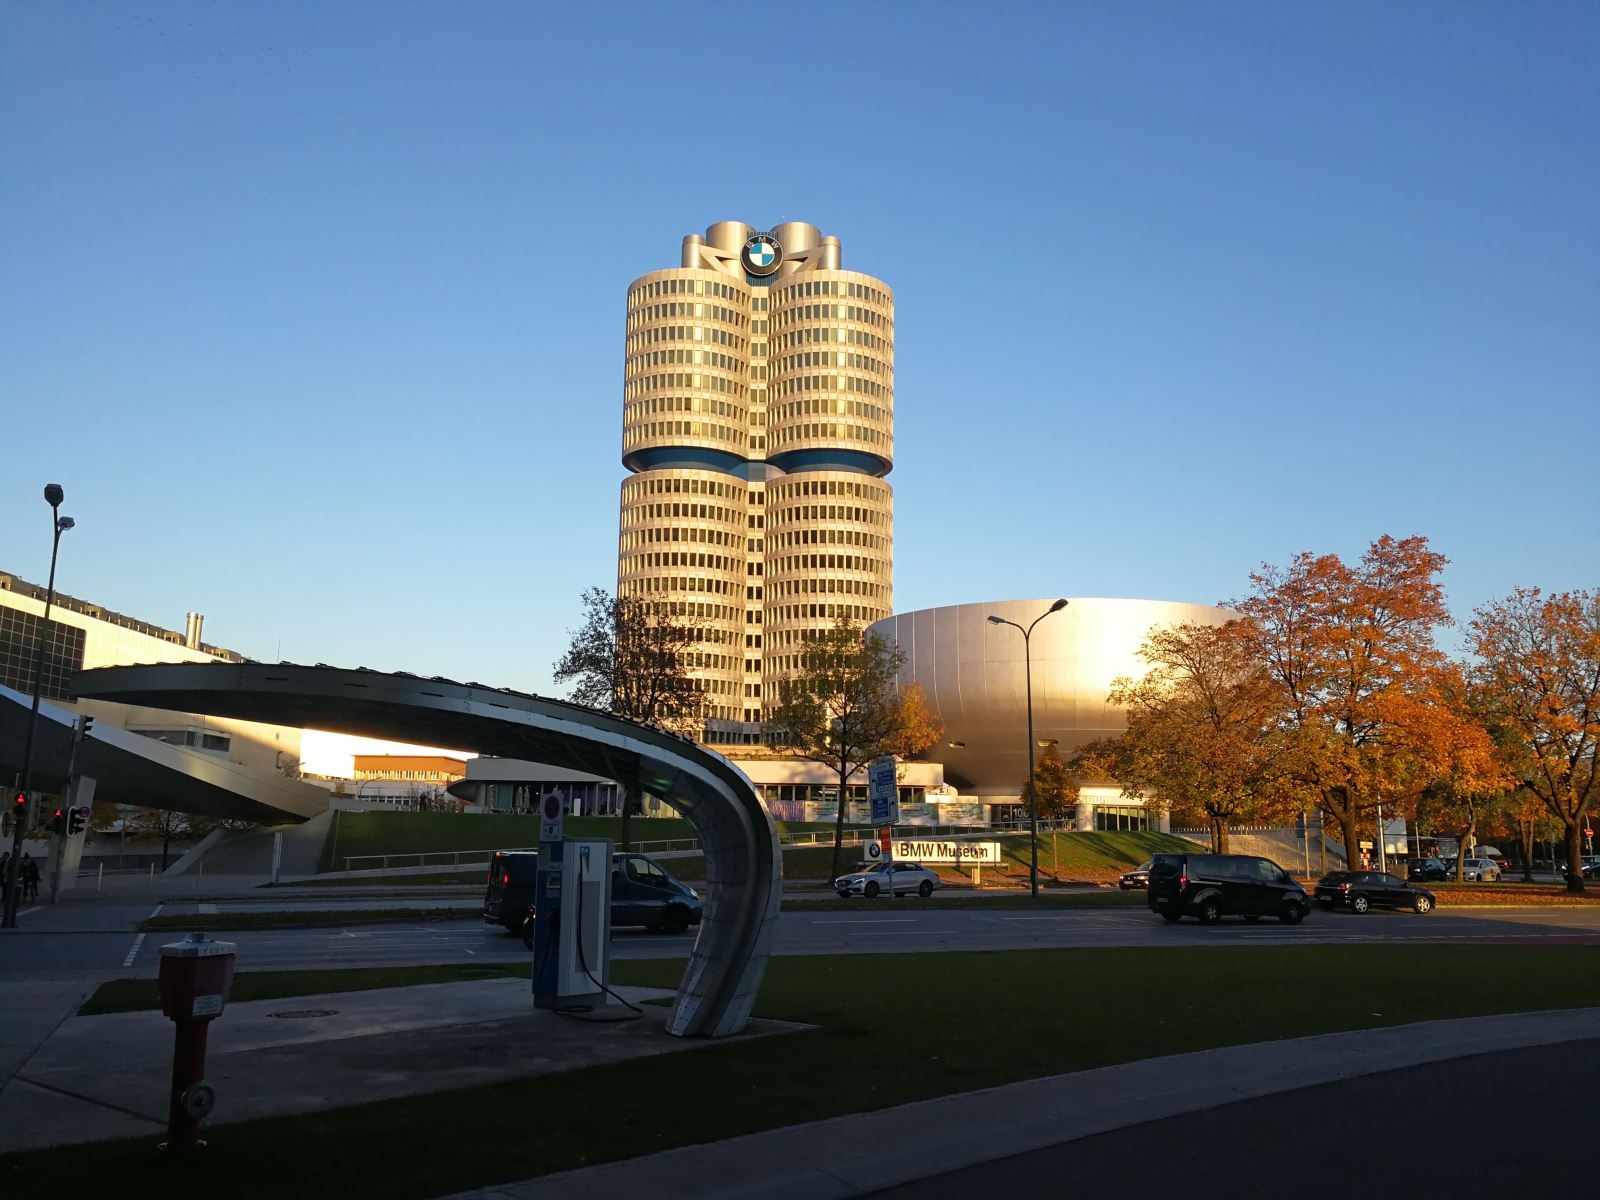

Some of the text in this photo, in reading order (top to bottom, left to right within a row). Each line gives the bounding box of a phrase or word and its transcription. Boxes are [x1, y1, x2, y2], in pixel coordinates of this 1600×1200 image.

[746, 236, 780, 249] BMW
[900, 843, 988, 858] BMW Museum
